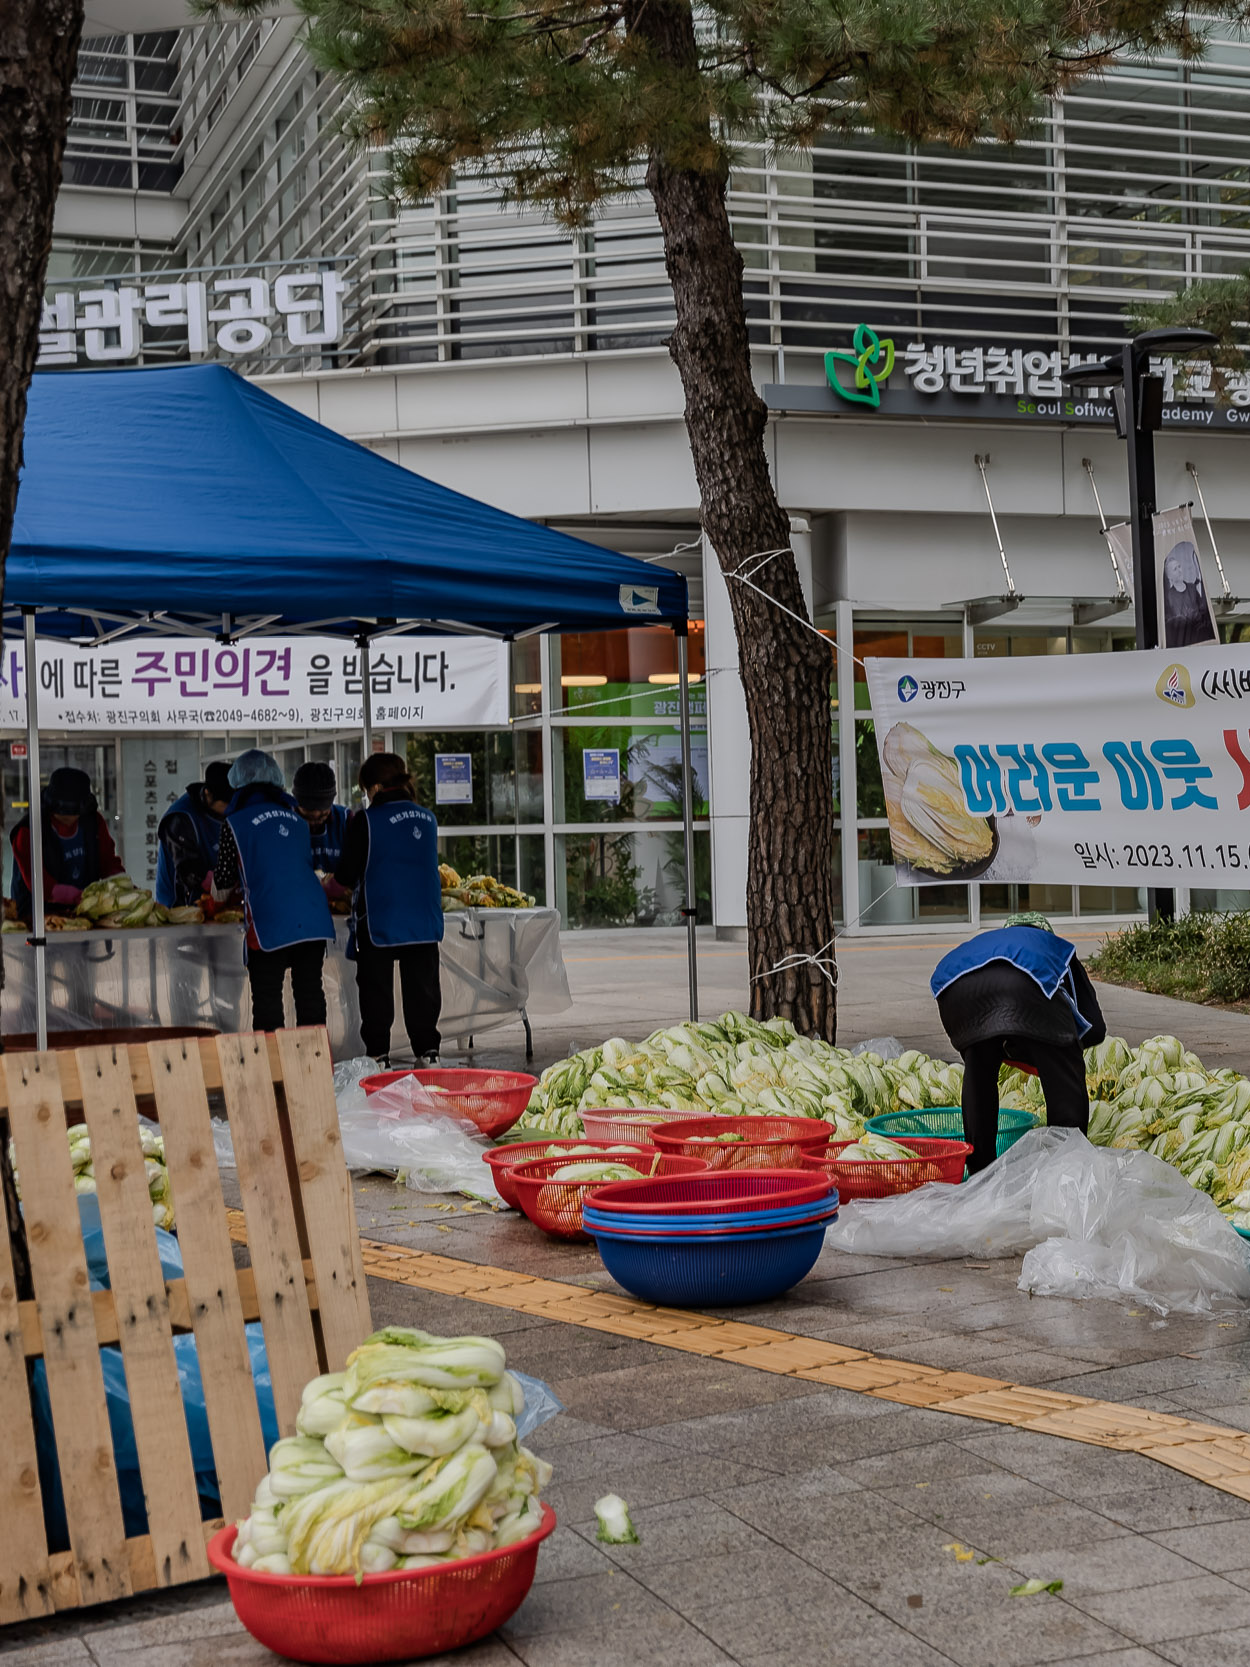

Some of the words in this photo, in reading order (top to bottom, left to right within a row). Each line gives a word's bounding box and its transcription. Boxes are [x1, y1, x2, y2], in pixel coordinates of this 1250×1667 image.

[1017, 401, 1061, 416] Seoul
[1065, 402, 1114, 418] Softwa
[1161, 409, 1215, 425] ademy
[976, 642, 996, 651] CCTV
[41, 658, 64, 698] 에
[73, 658, 122, 698] 따른
[131, 647, 291, 697] 주민의견
[306, 654, 333, 695] 을
[920, 680, 966, 700] 광진구
[106, 710, 161, 724] 광진구의회
[375, 705, 424, 720] 홈페이지
[954, 742, 1101, 813] 어려운
[1102, 739, 1218, 811] 이웃
[1074, 842, 1120, 869] 일시:
